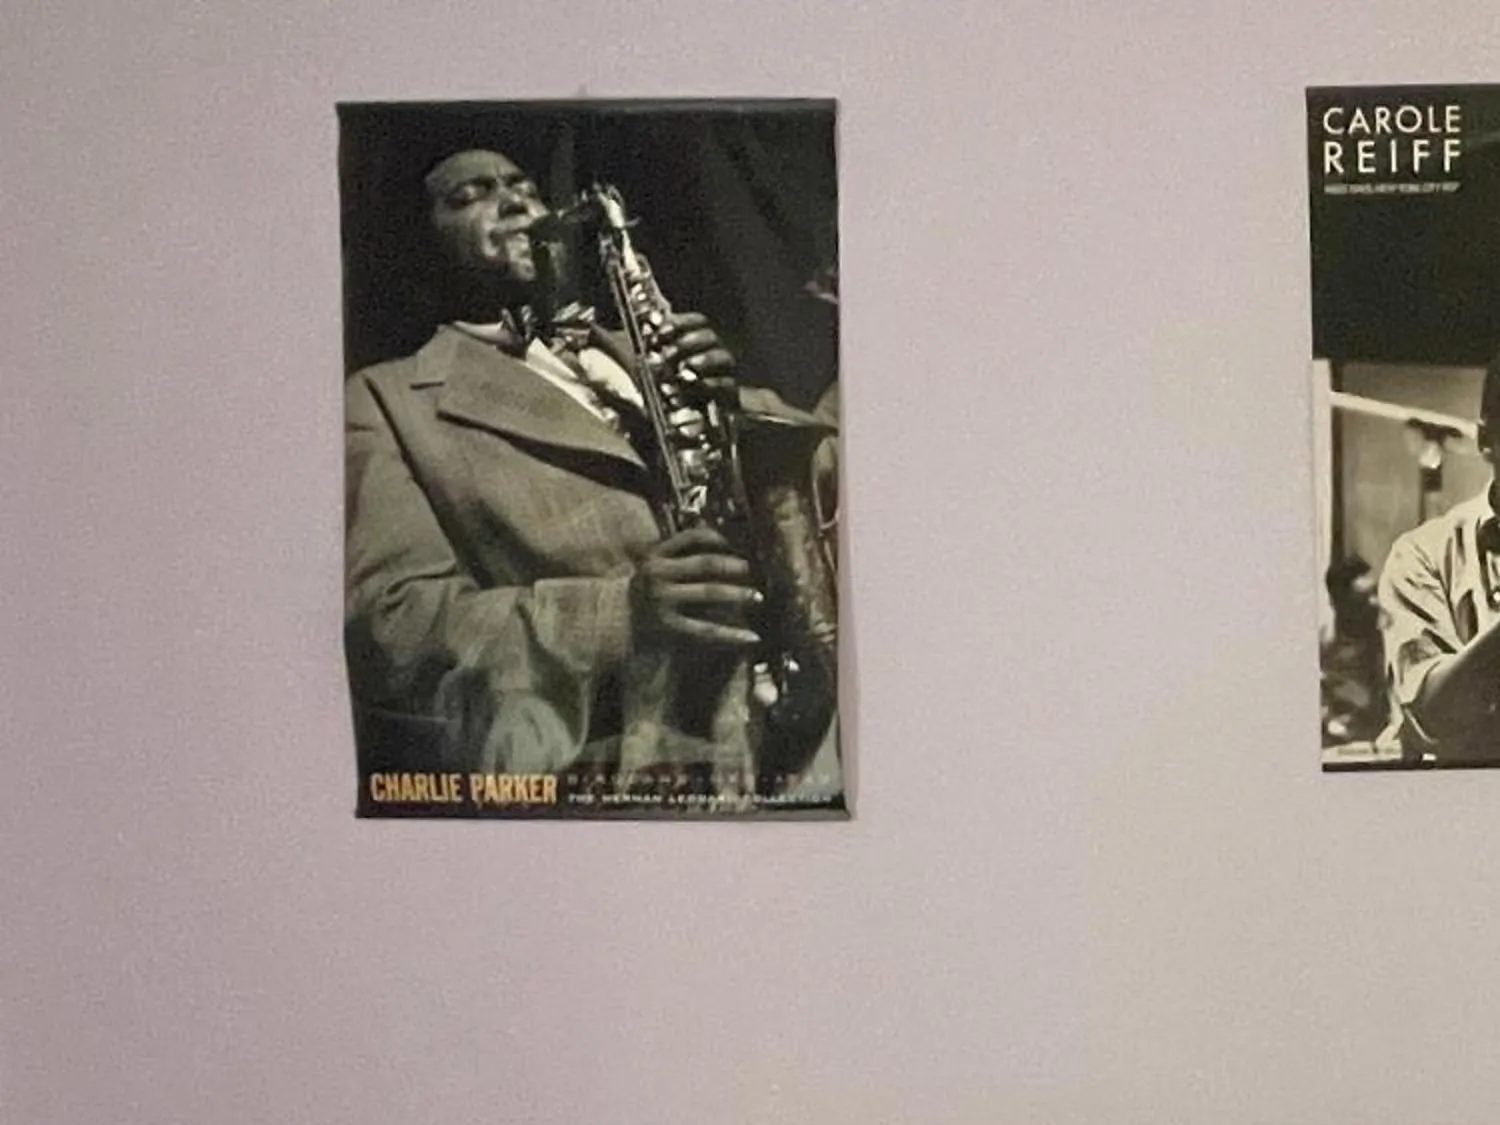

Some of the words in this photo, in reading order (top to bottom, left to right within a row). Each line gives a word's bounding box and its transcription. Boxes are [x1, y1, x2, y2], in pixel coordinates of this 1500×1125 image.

[1323, 105, 1461, 134] CAROLE
[1323, 139, 1461, 174] REIFF
[370, 772, 463, 803] CHARLIE
[470, 773, 558, 804] PARKER
